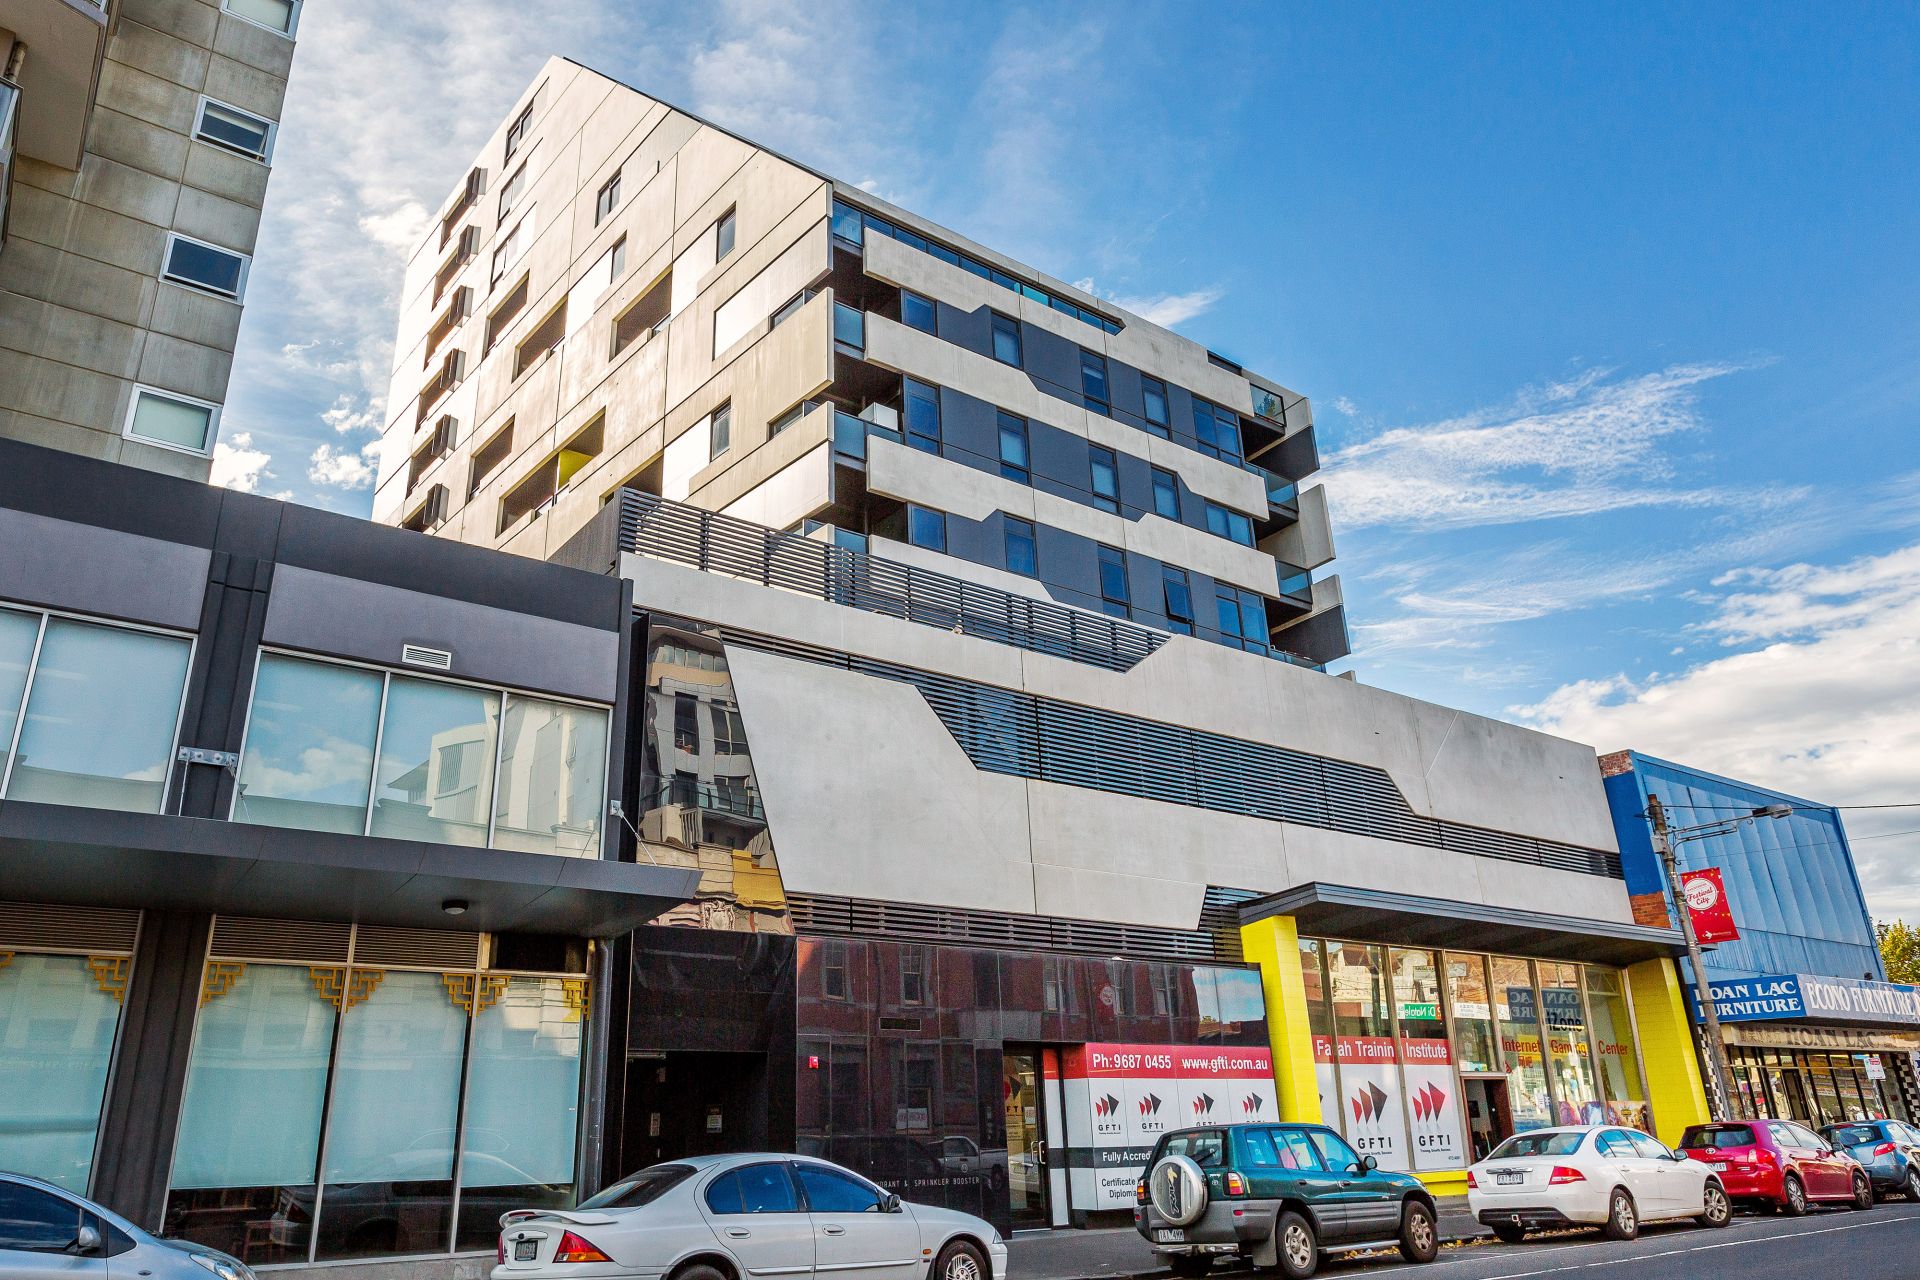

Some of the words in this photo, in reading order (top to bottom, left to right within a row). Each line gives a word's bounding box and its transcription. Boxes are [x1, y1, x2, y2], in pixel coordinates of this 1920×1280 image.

[1687, 887, 1713, 901] Festival
[1697, 897, 1710, 905] City
[1755, 981, 1797, 996] LAC
[1806, 982, 1850, 1012] ECONO
[1850, 987, 1916, 1015] FURNITURE
[1317, 1040, 1352, 1056] Faah
[1406, 1042, 1447, 1058] Institute
[1502, 1035, 1541, 1052] Internet
[1551, 1039, 1588, 1057] Gamng
[1598, 1040, 1628, 1055] Center
[1092, 1053, 1112, 1068] Ph:
[1114, 1053, 1141, 1069] 9687
[1145, 1055, 1171, 1069] 0455
[1182, 1055, 1268, 1073] www.gfti.com.au
[1006, 1105, 1024, 1113] FTI
[1098, 1124, 1121, 1132] GFTI
[1142, 1122, 1164, 1130] GFTI
[1358, 1136, 1392, 1149] GFTI
[1418, 1134, 1450, 1147] GFTI
[1102, 1152, 1121, 1163] Fully
[1123, 1151, 1152, 1161] Accred
[914, 1178, 950, 1187] SPRINKLER
[953, 1176, 980, 1185] BOOSTER
[1101, 1177, 1136, 1187] Certificate
[1109, 1189, 1137, 1200] Diploma
